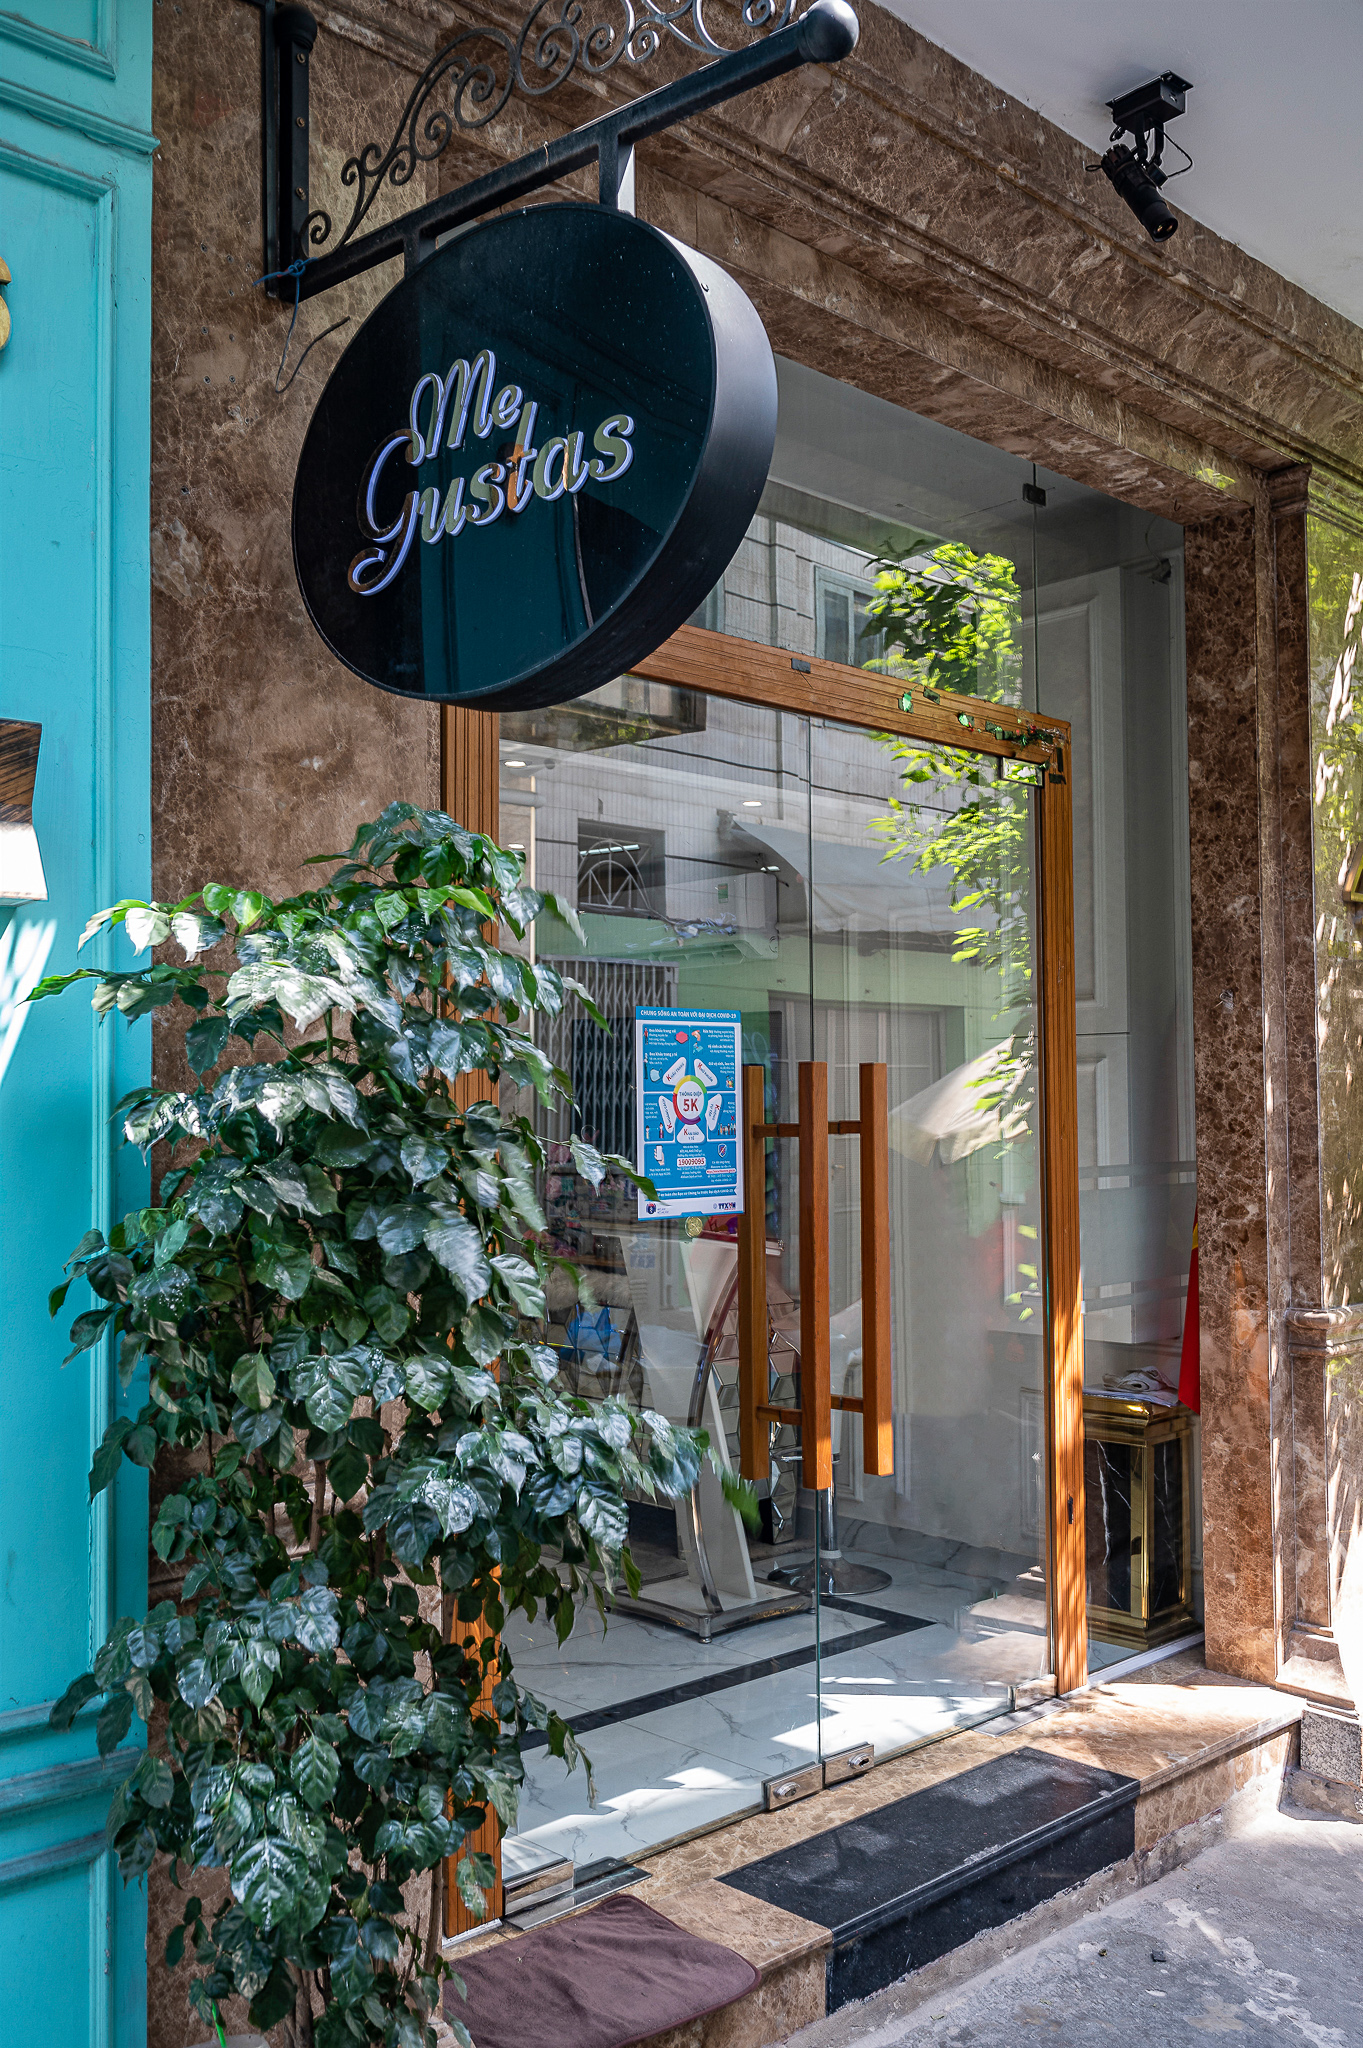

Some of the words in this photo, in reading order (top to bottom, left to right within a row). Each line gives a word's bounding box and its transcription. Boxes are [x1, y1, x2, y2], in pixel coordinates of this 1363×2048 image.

[409, 349, 523, 459] Me
[348, 402, 635, 596] Gustas
[640, 1009, 657, 1017] CHUNG
[657, 1009, 670, 1017] SỐNG
[706, 1012, 716, 1020] DỊCH
[683, 1098, 699, 1112] 5K
[678, 1158, 704, 1166] 19009095
